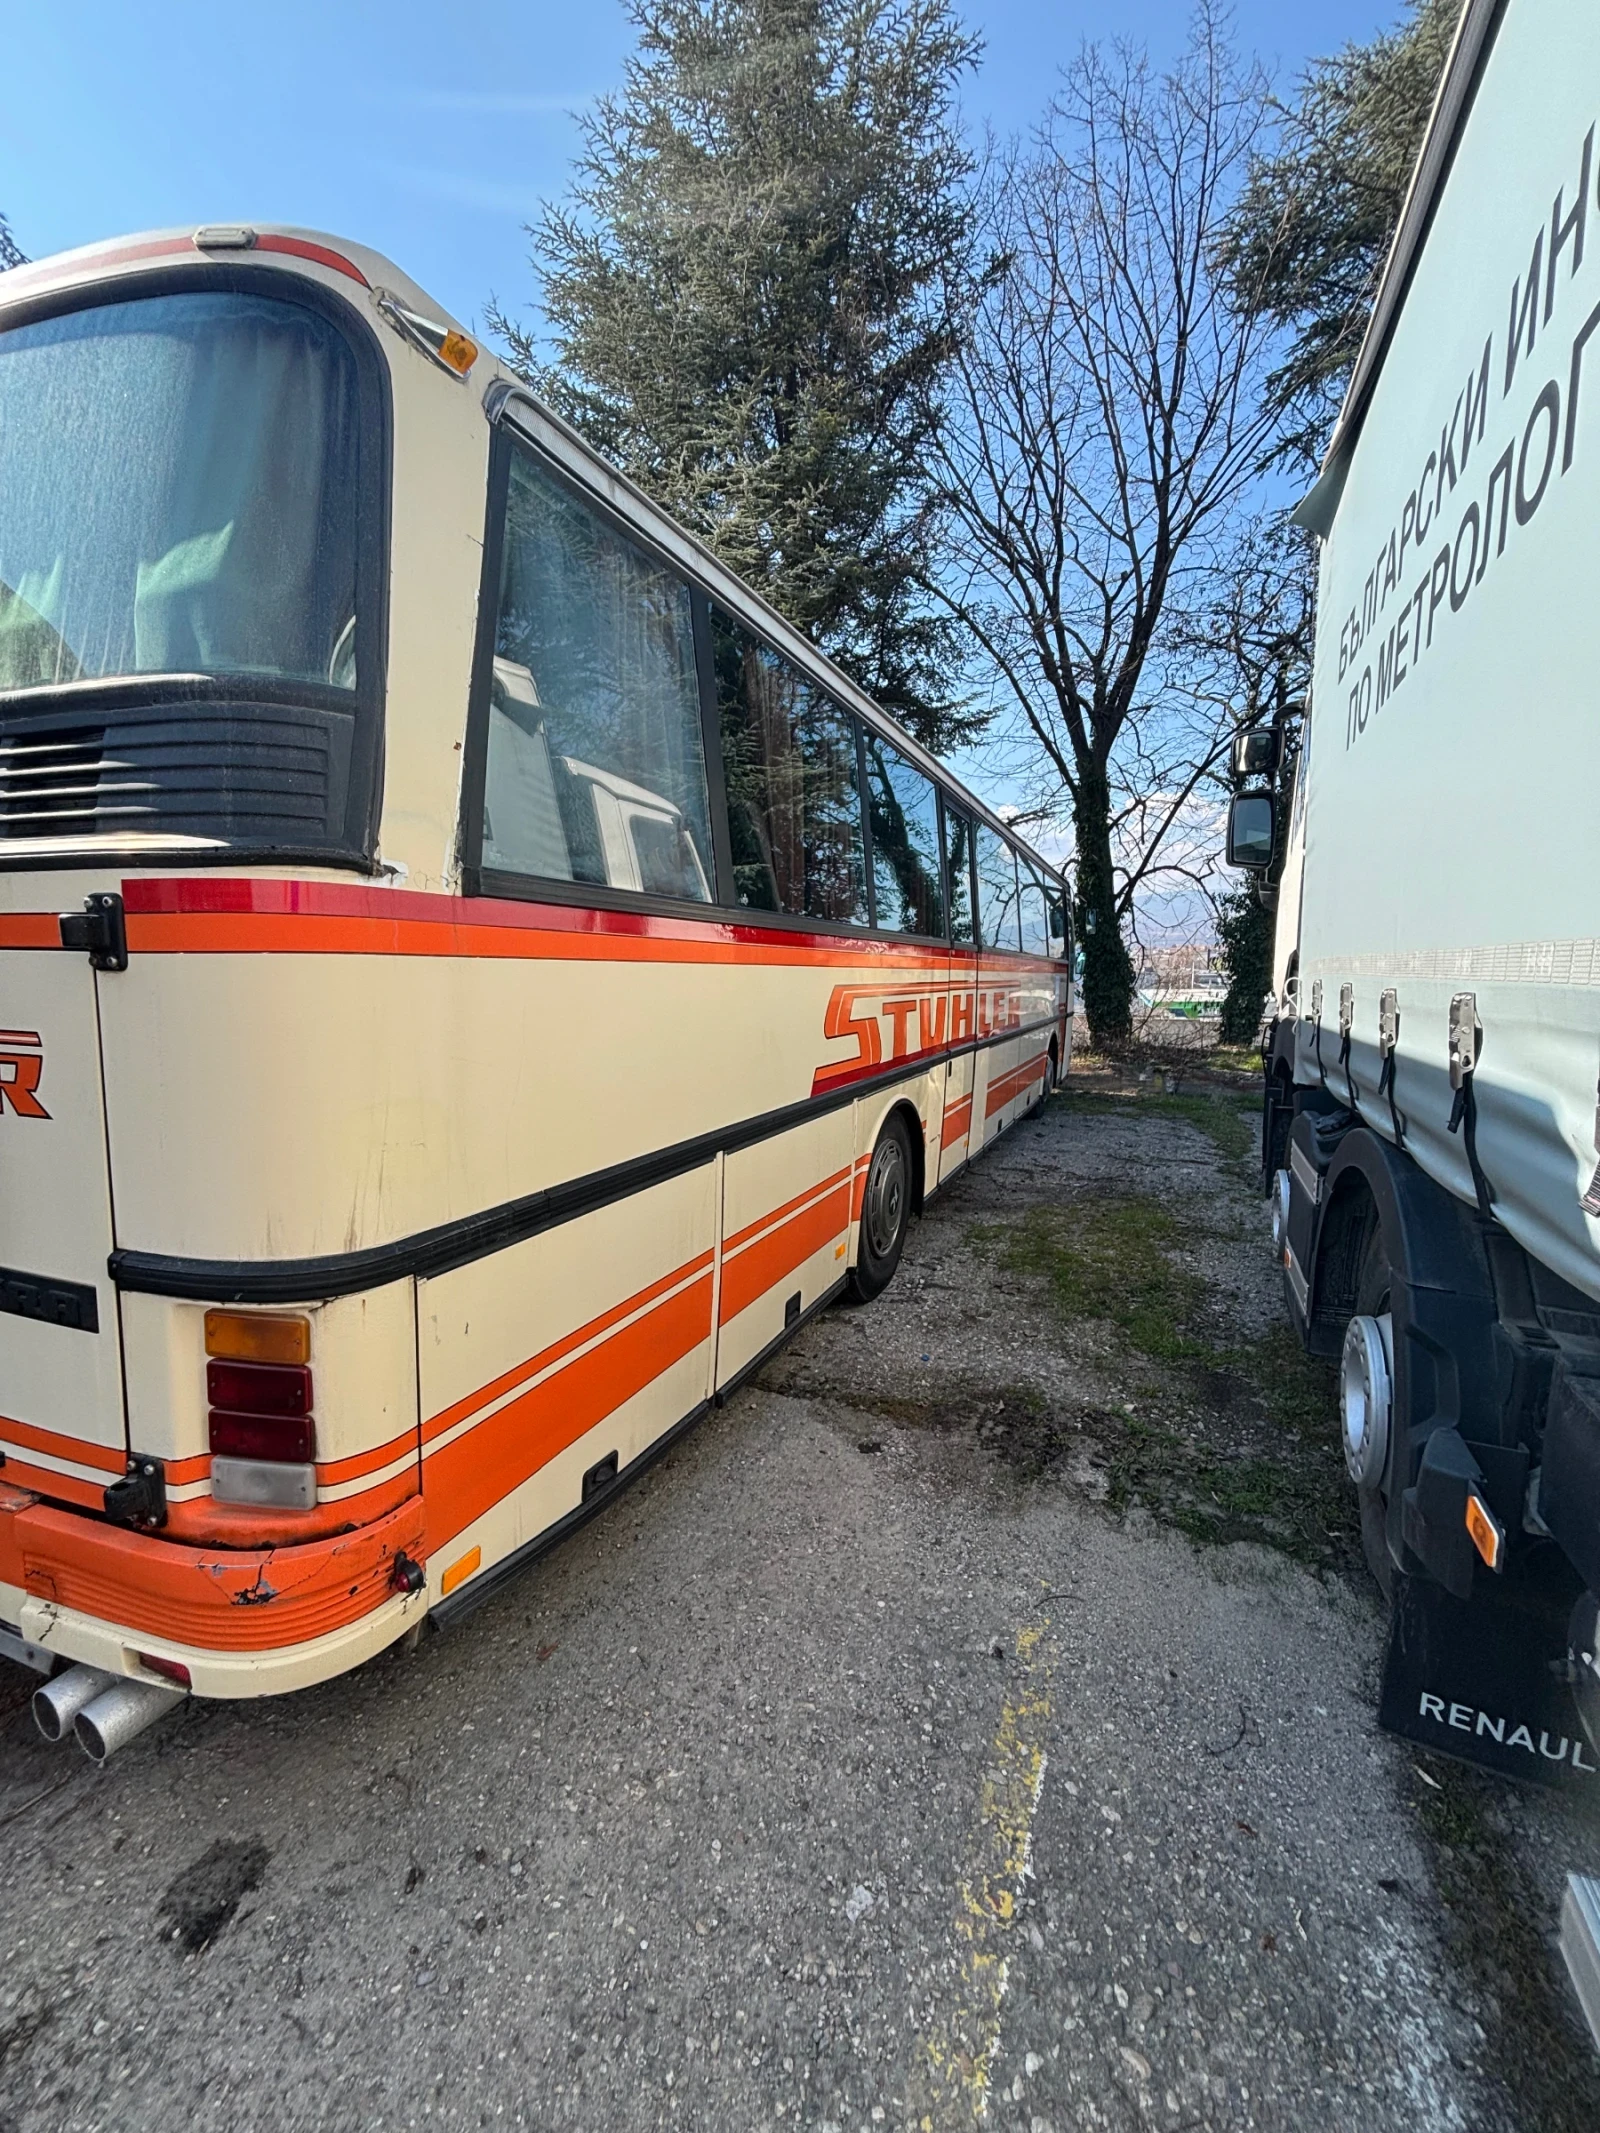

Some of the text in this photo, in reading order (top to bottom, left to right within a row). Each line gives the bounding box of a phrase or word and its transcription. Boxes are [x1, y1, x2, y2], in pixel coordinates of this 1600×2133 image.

[1338, 118, 1600, 686] БЪЛГАРСКИ ИН
[1346, 664, 1372, 752] ПО
[1419, 1691, 1597, 1773] RENAUL
